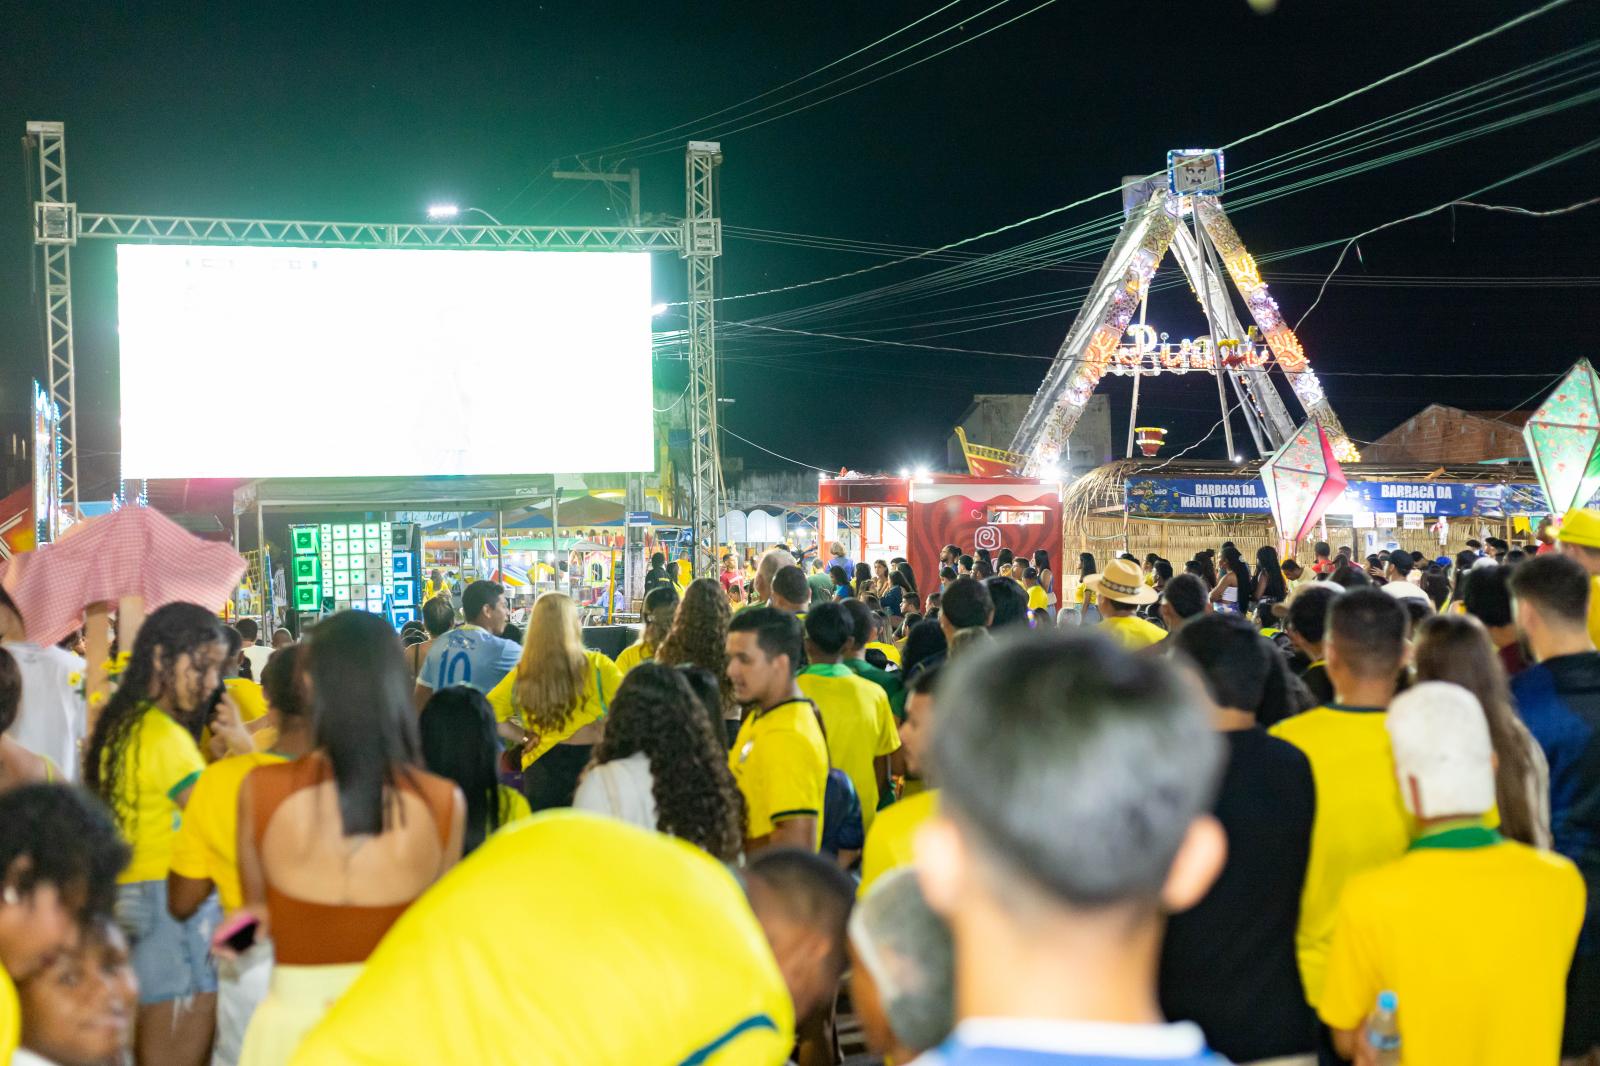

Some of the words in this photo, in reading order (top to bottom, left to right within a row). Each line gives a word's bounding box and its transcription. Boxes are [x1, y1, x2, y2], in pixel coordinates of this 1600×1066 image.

[1195, 484, 1241, 497] BARRACA
[1242, 484, 1256, 496] DA
[1381, 484, 1435, 499] BARRACA
[1436, 486, 1452, 499] DA
[1180, 496, 1212, 508] MARIA
[1214, 496, 1226, 508] DE
[1227, 496, 1271, 509] LOURDES
[1396, 499, 1437, 514] ELDENY
[438, 650, 472, 689] 10
